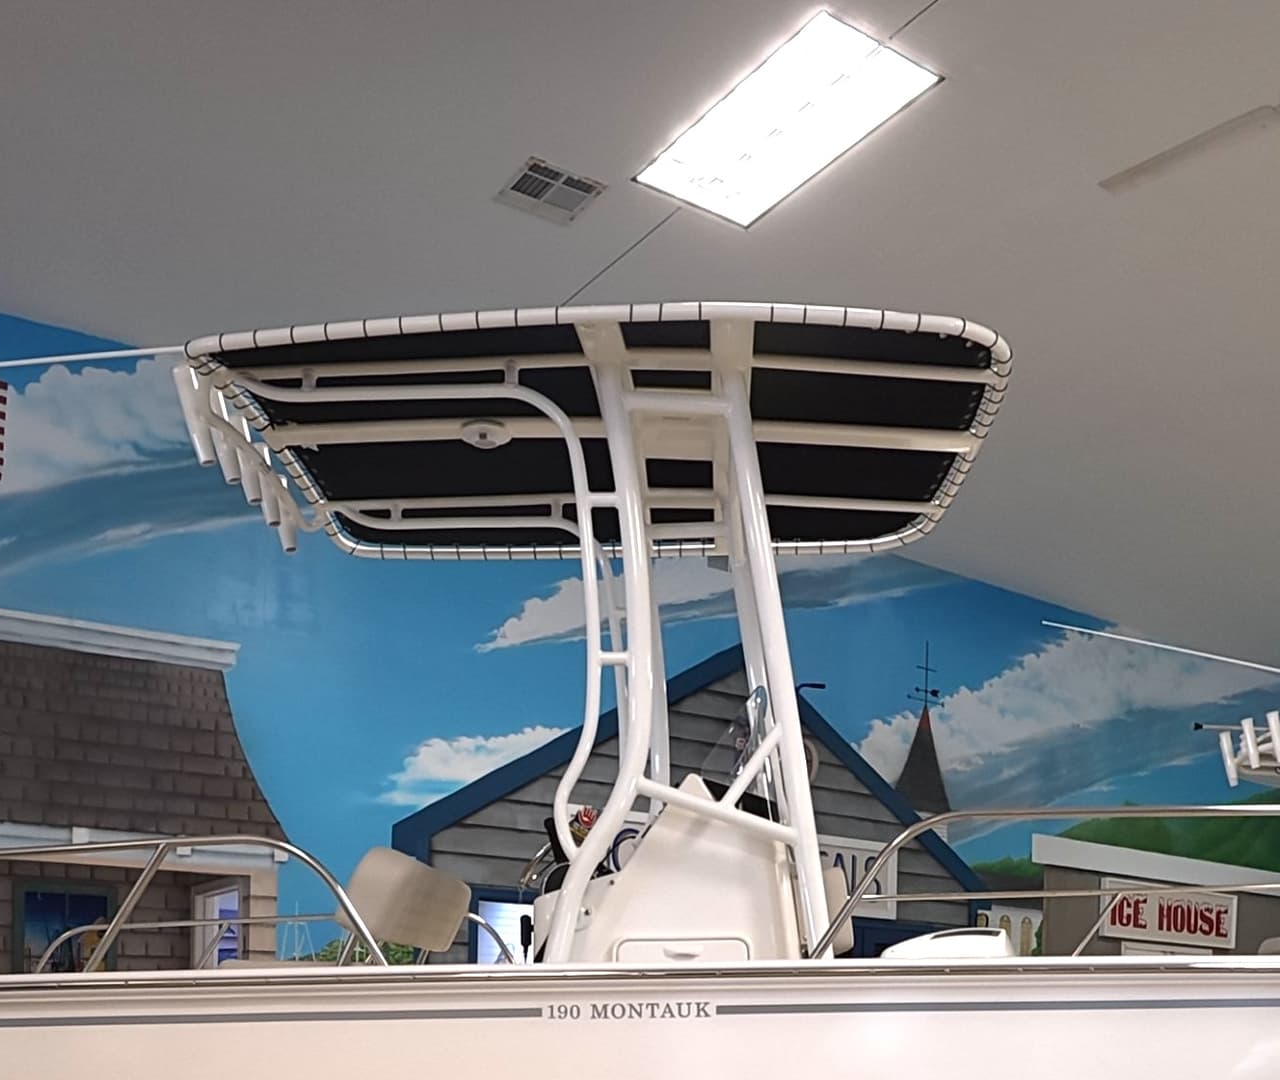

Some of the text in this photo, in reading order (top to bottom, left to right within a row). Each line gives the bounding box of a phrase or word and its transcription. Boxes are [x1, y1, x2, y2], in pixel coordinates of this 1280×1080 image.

[1109, 890, 1229, 938] ICE HOUSE
[547, 1002, 711, 1020] 190 MONTAUK
